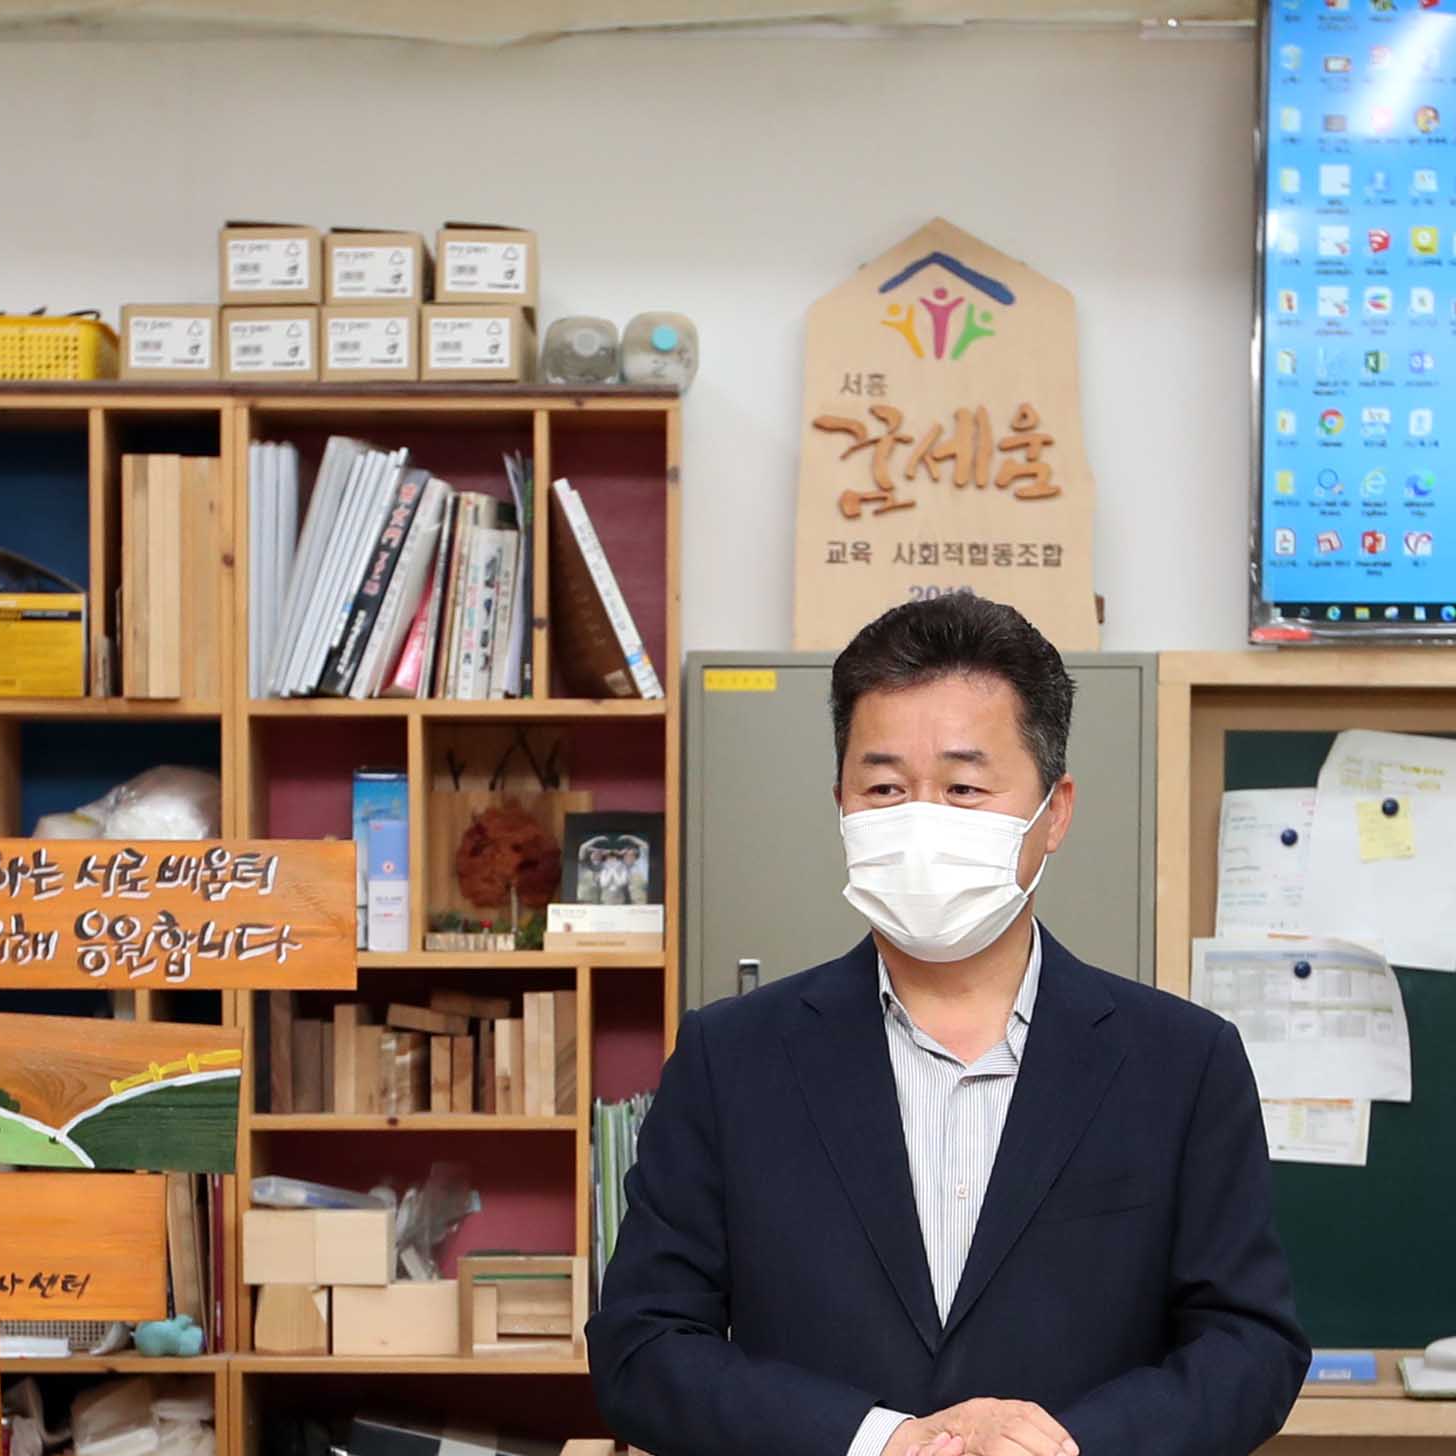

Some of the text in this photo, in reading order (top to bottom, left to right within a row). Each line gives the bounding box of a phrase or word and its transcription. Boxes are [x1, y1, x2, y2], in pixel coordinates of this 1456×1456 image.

[825, 541, 1064, 568] 교육 사회적협동조합
[74, 908, 304, 984] 응원합니다
